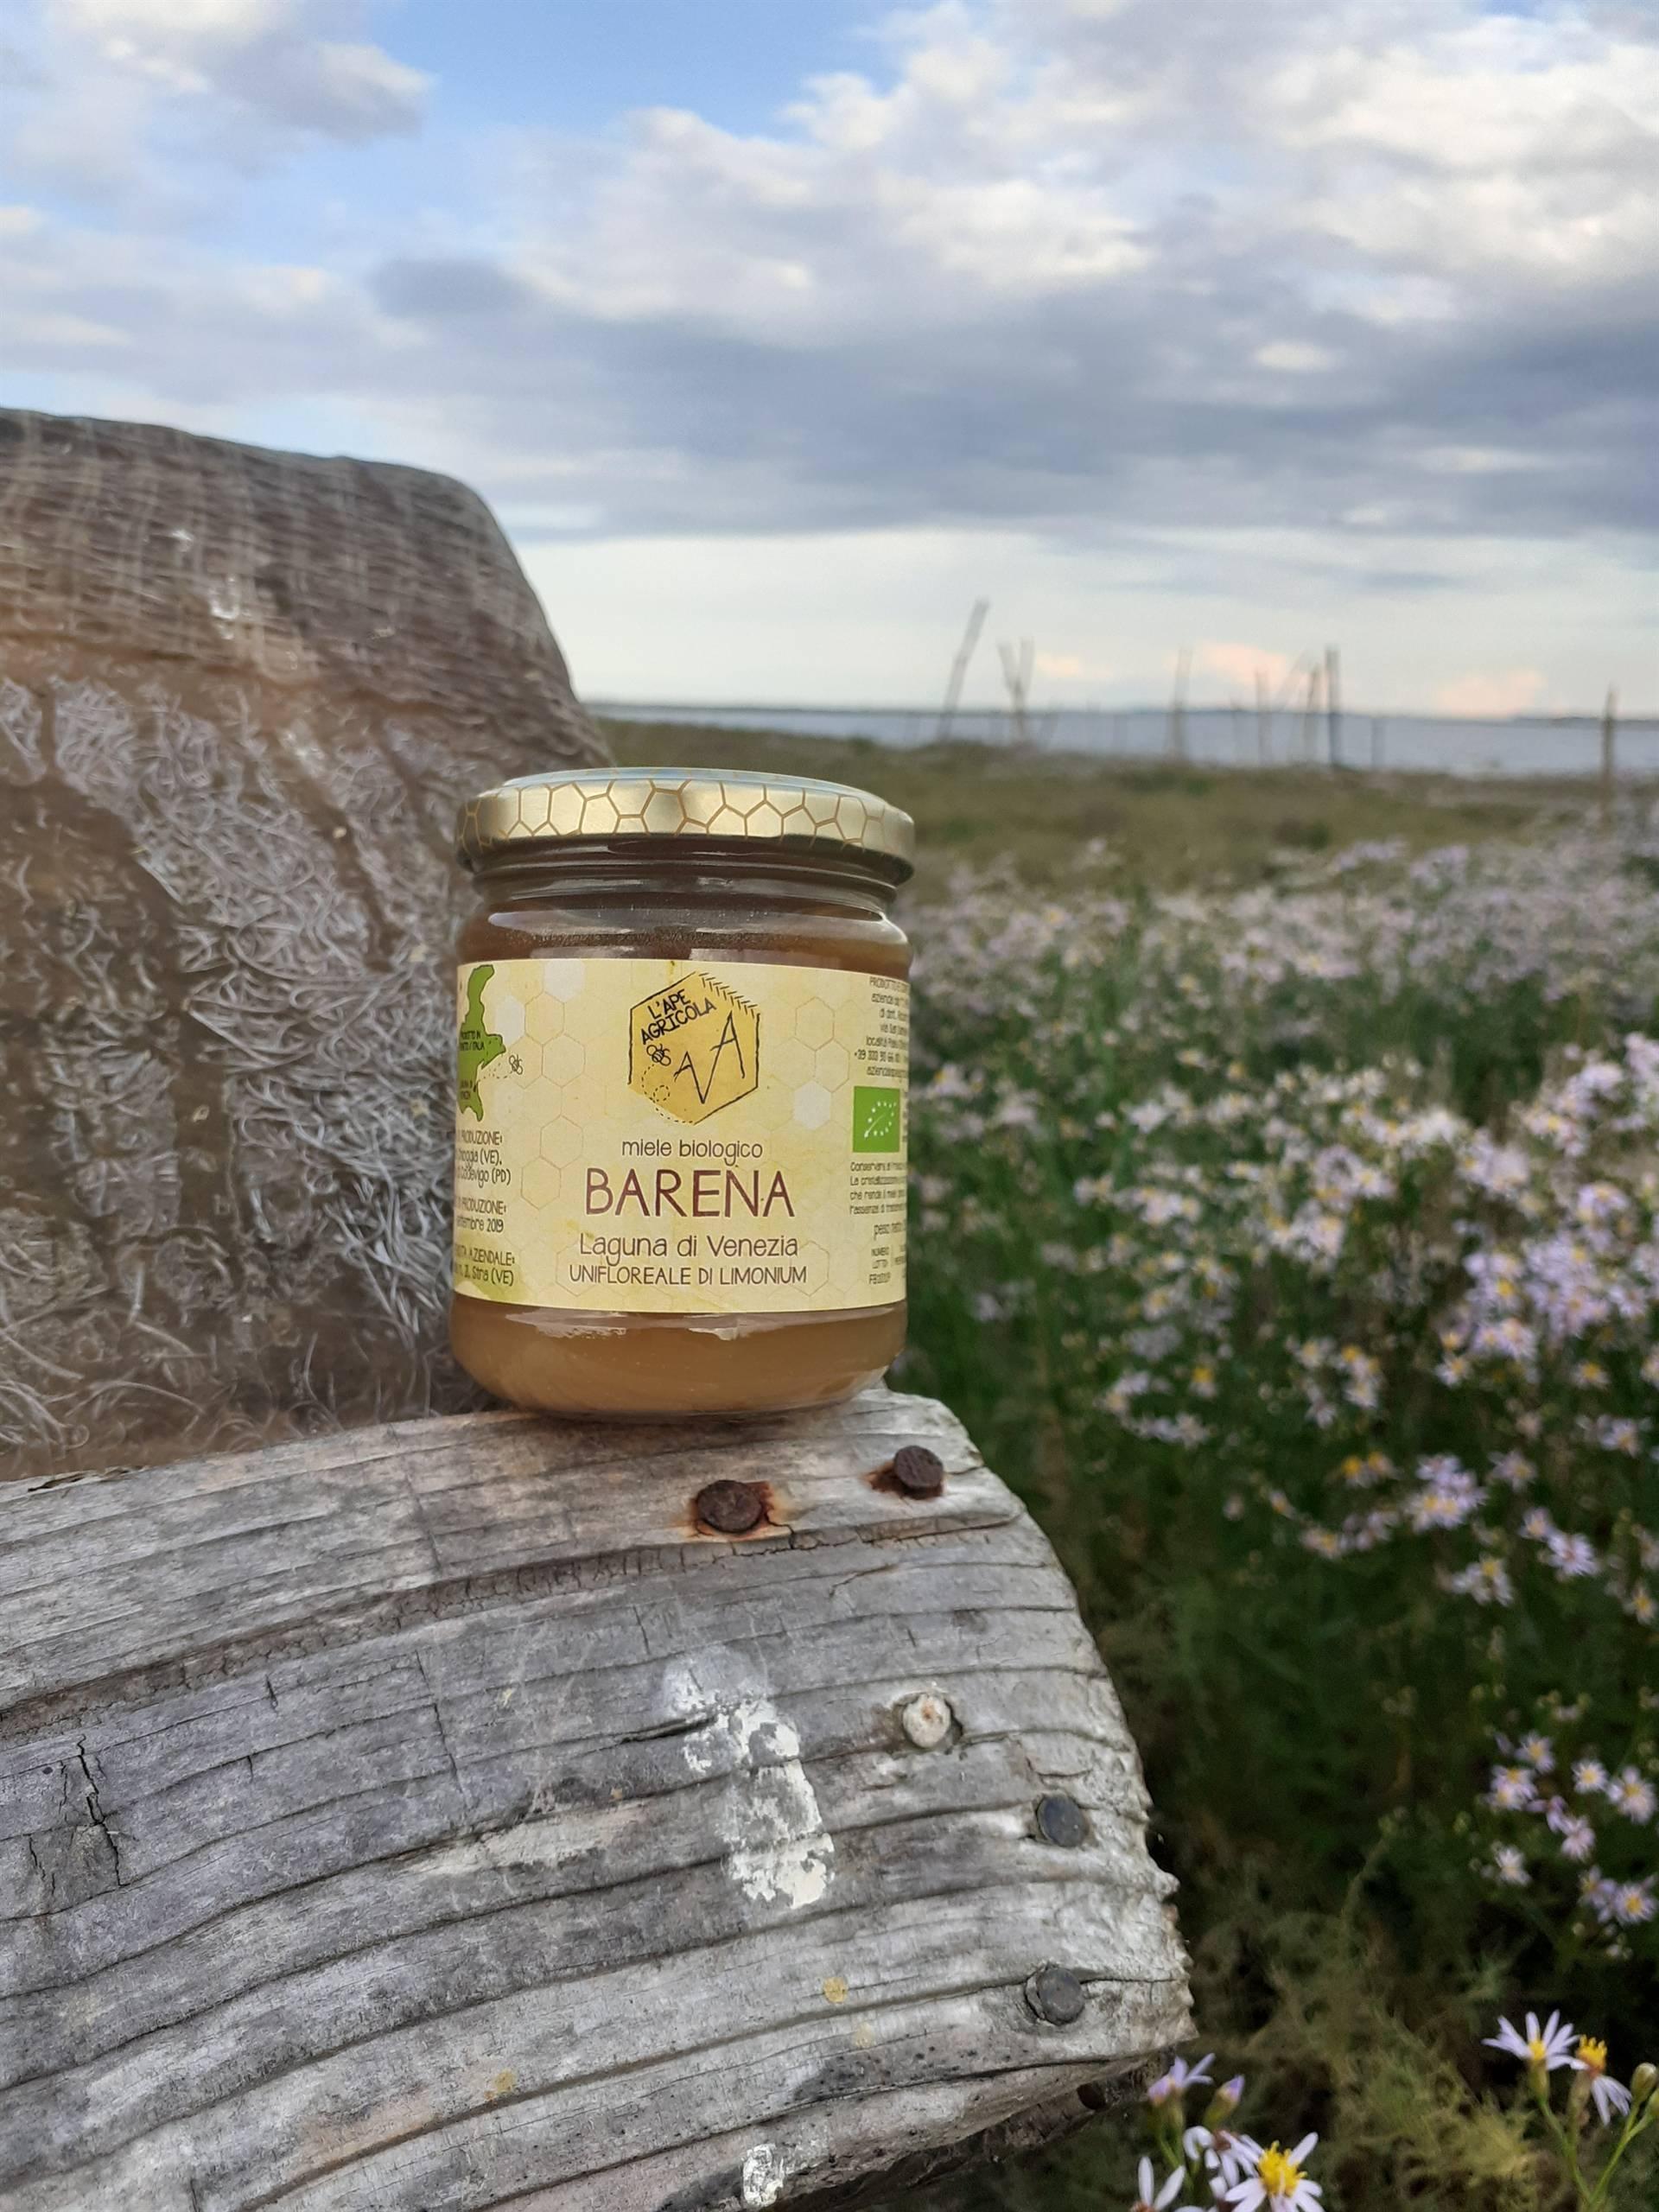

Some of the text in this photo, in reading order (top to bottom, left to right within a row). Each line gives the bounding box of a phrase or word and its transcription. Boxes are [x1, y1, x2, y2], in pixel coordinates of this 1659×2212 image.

[647, 988, 691, 1020] L'APE
[641, 997, 717, 1045] AGRICOLA
[621, 1139, 763, 1166] miele biologico
[492, 1167, 512, 1186] (PD)
[585, 1167, 796, 1217] BARENA
[486, 1218, 504, 1233] 2019
[580, 1232, 798, 1267] Laguna di Venezia
[491, 1268, 514, 1287] (VE)
[569, 1265, 807, 1286] UNIFLOREALE DI LIMONIUM
